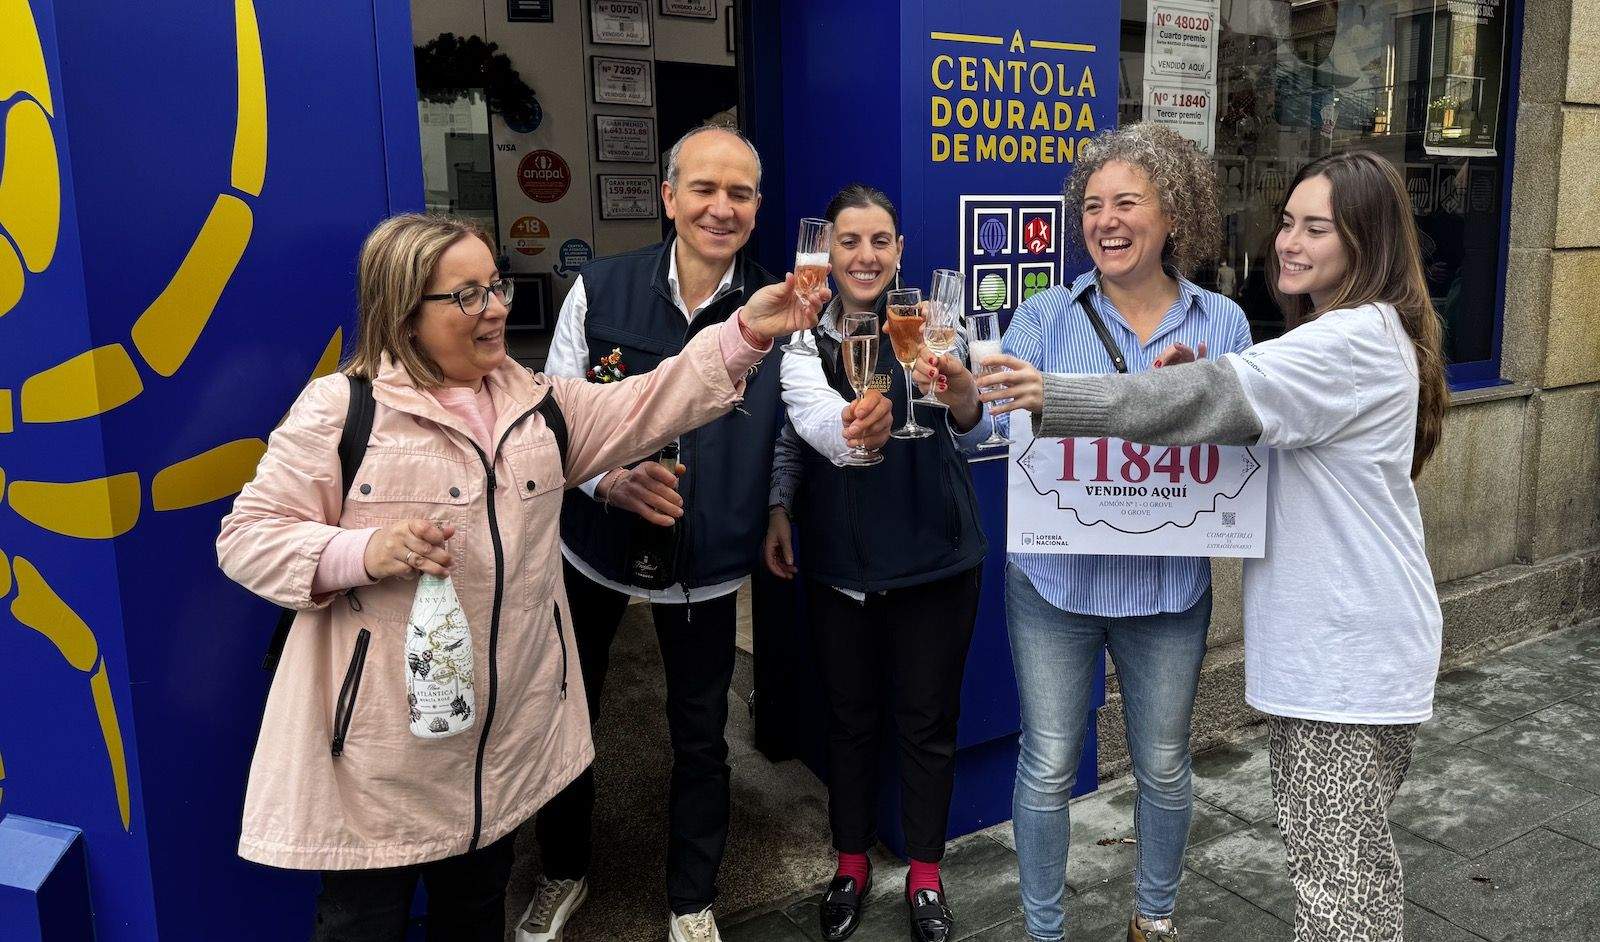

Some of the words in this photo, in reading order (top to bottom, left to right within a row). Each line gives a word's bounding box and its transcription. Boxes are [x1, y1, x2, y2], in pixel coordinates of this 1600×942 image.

[1157, 13, 1172, 27] Nº
[1174, 16, 1209, 31] 48020
[1009, 29, 1025, 54] A
[1159, 30, 1182, 40] Cuarto
[1183, 34, 1206, 42] premio
[613, 65, 641, 76] 72897
[1158, 60, 1186, 70] VENDIDO
[1188, 62, 1205, 72] AQUÍ
[931, 54, 1096, 98] CENTOLA
[1154, 92, 1168, 105] Nº
[1172, 94, 1206, 108] 11840
[931, 96, 1095, 132] DOURADA
[1157, 109, 1177, 118] Tercer
[1179, 111, 1202, 120] premio
[497, 143, 517, 152] VISA
[931, 133, 969, 163] DE
[523, 168, 565, 181] anapal
[517, 219, 541, 234] +18
[1055, 436, 1220, 485] 11840
[1085, 485, 1148, 497] VENDIDO
[1151, 484, 1188, 499] AQUÍ
[1099, 500, 1125, 508] ADMÓN
[1149, 501, 1173, 509] GROVE
